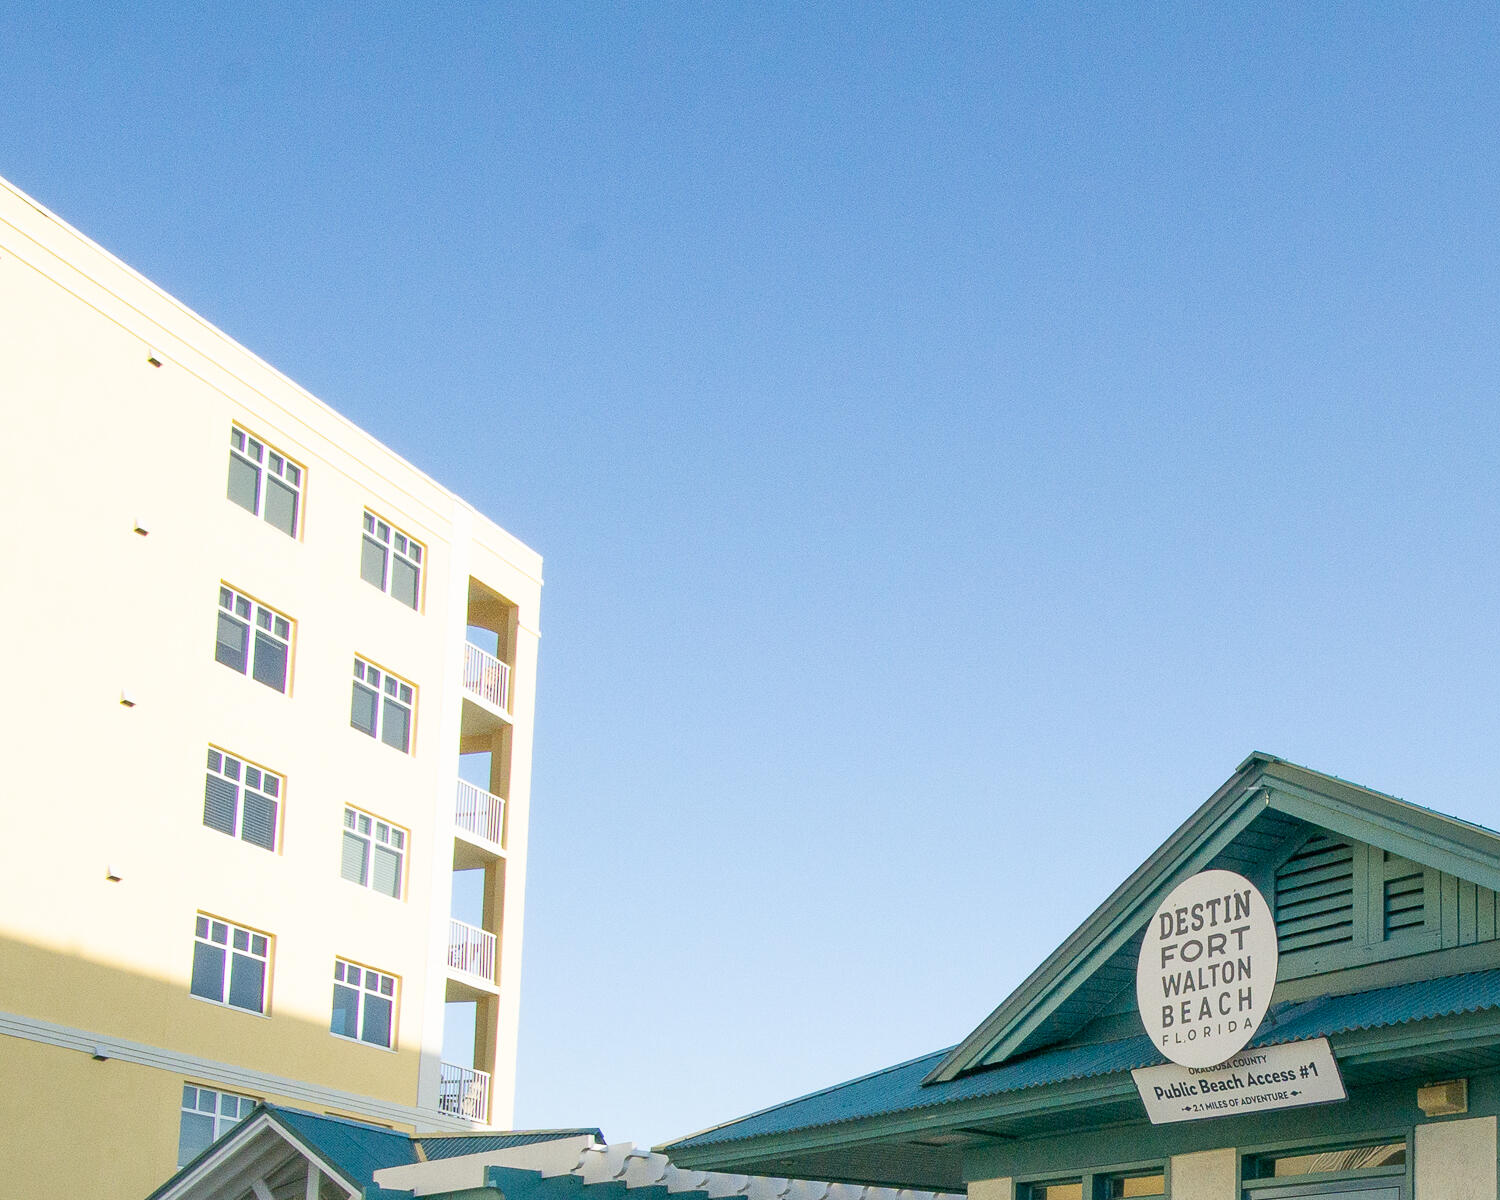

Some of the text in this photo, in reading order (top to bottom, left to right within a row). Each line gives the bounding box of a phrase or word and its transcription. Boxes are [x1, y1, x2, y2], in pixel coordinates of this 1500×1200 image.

[1159, 889, 1252, 940] DESTIN
[1161, 925, 1251, 969] FORT
[1162, 955, 1252, 998] WALTON
[1162, 987, 1252, 1028] BEACH
[1162, 1017, 1253, 1046] FLORIDA
[1154, 1061, 1319, 1101] Public Beach Access #1
[1233, 1054, 1267, 1068] COUNTY
[1193, 1091, 1289, 1112] 2.1 MILES OF ADVENTURE
